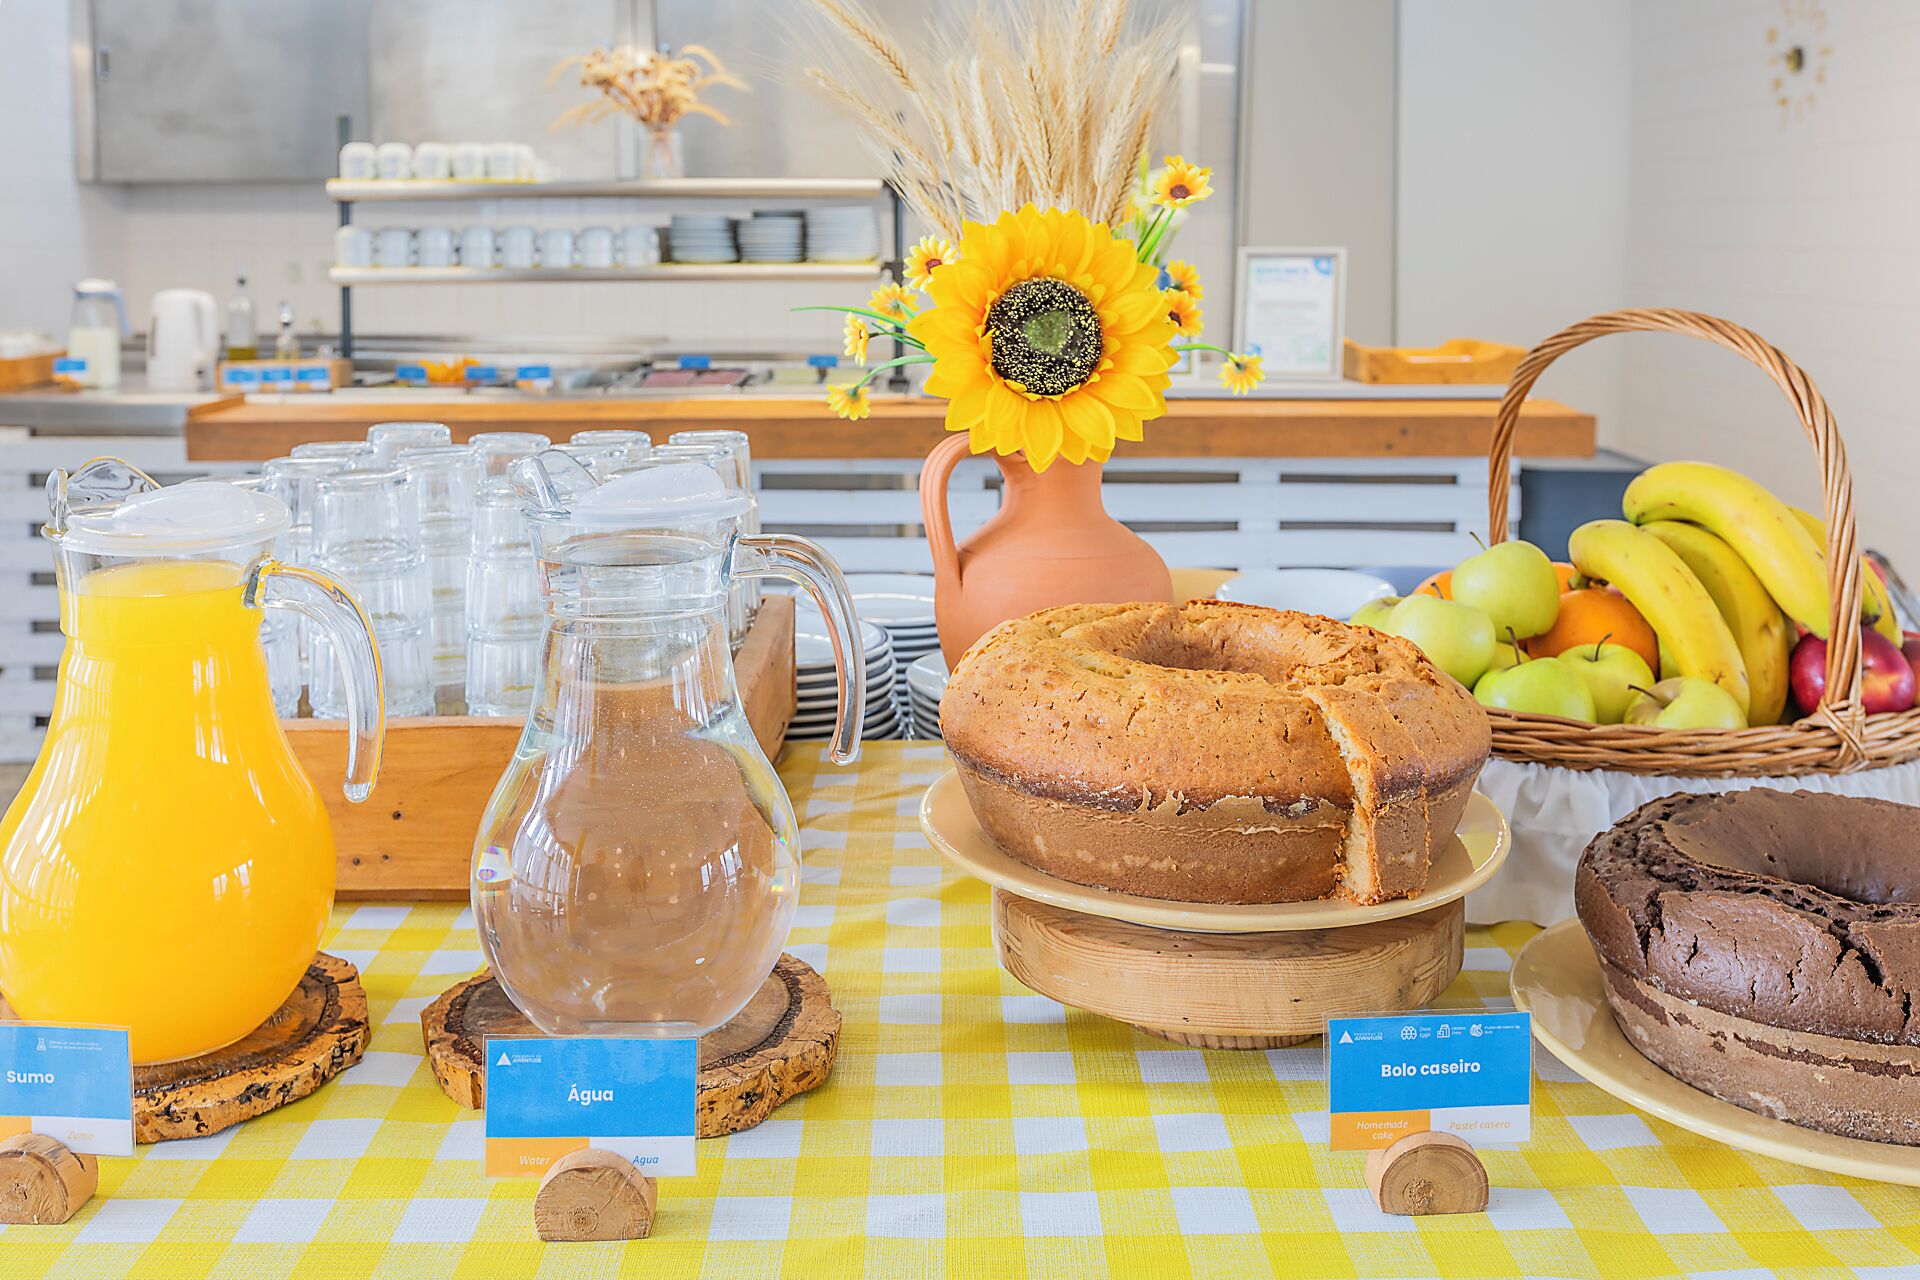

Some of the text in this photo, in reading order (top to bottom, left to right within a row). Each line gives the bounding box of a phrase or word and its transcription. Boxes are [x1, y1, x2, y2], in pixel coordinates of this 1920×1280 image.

[1381, 1059, 1481, 1078] Bolo caseiro
[6, 1070, 55, 1084] Sumo
[567, 1083, 614, 1106] Água
[1356, 1119, 1409, 1131] Homemade
[1449, 1120, 1511, 1130] Pastel casera
[1372, 1131, 1393, 1140] cake
[519, 1155, 551, 1167] Water
[632, 1155, 659, 1168] Agua
